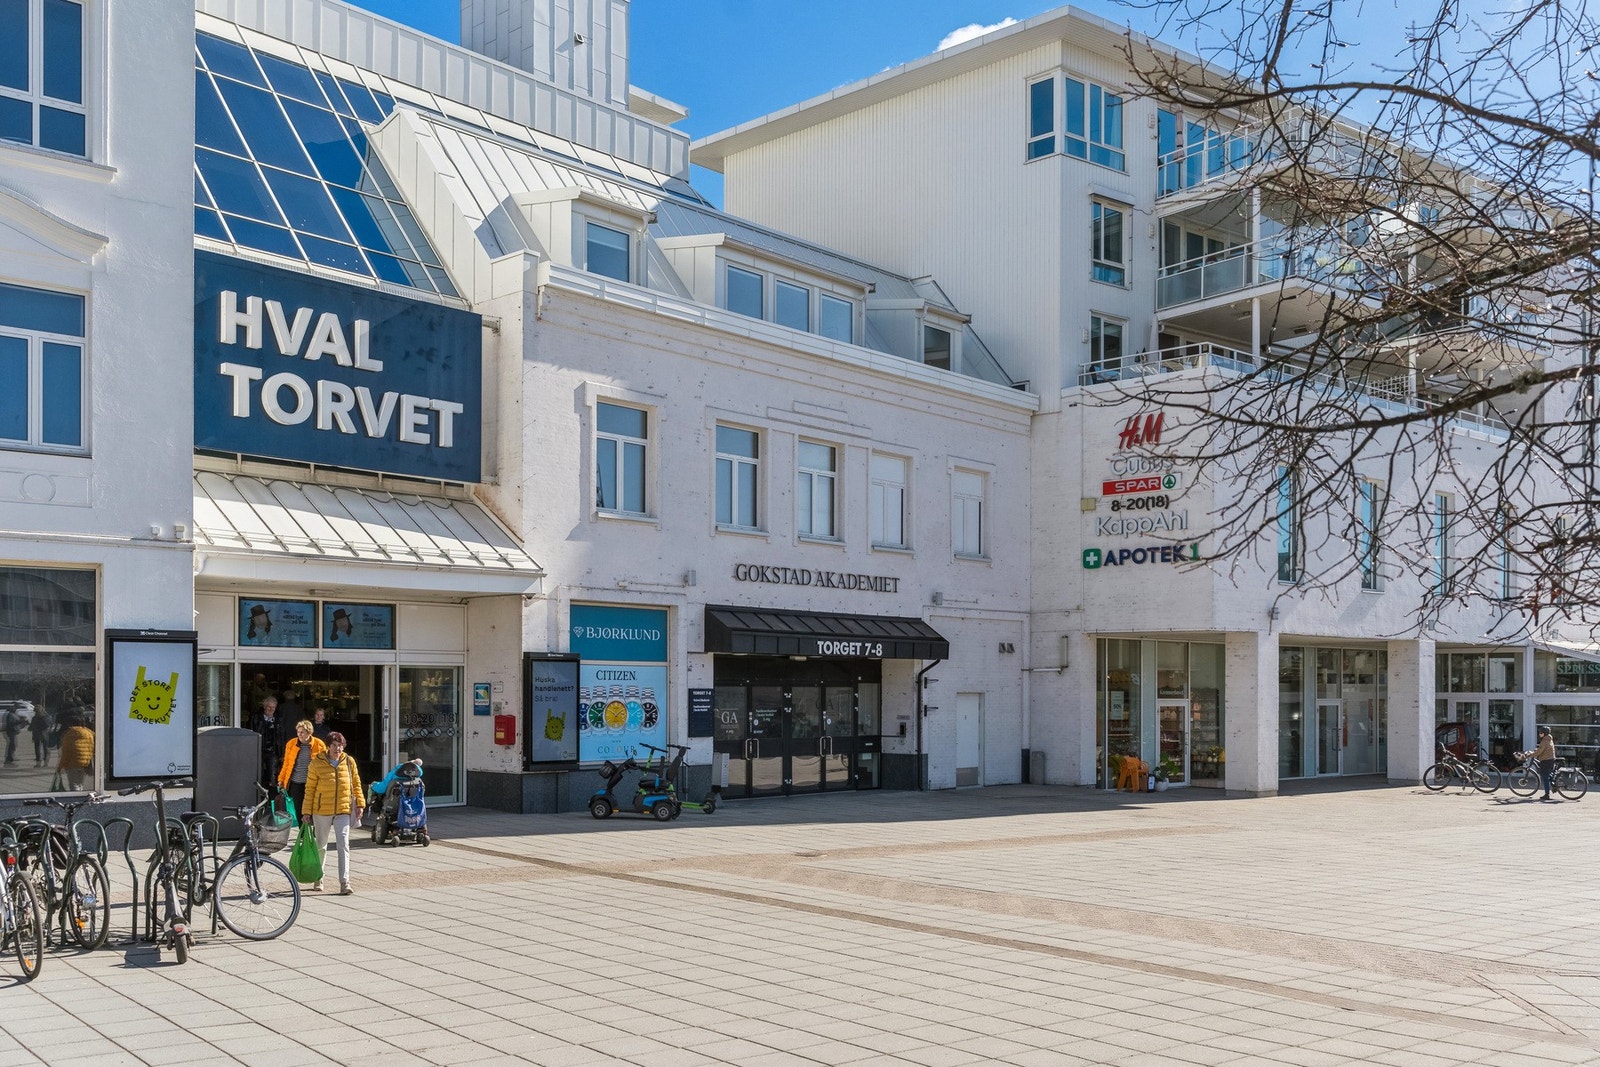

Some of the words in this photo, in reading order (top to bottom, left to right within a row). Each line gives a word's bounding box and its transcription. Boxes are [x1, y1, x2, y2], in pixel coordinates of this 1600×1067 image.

[220, 290, 383, 372] HVAL
[220, 362, 463, 448] TORVET
[1118, 411, 1164, 450] H&M
[1115, 478, 1160, 492] SPAR
[1111, 495, 1170, 511] 8-20(18)
[1096, 509, 1189, 539] KappAhl
[1103, 545, 1188, 566] APOTEK
[736, 563, 812, 586] GOKSTAD
[815, 571, 900, 593] AKADEMIET
[586, 626, 661, 641] BJØRKLUND
[817, 640, 862, 656] TORGET
[865, 643, 883, 657] 7-8
[596, 669, 636, 681] CITIZEN
[129, 686, 141, 702] DET
[142, 679, 172, 692] STORE
[132, 698, 177, 725] POSEKUTTET
[721, 711, 738, 724] GA
